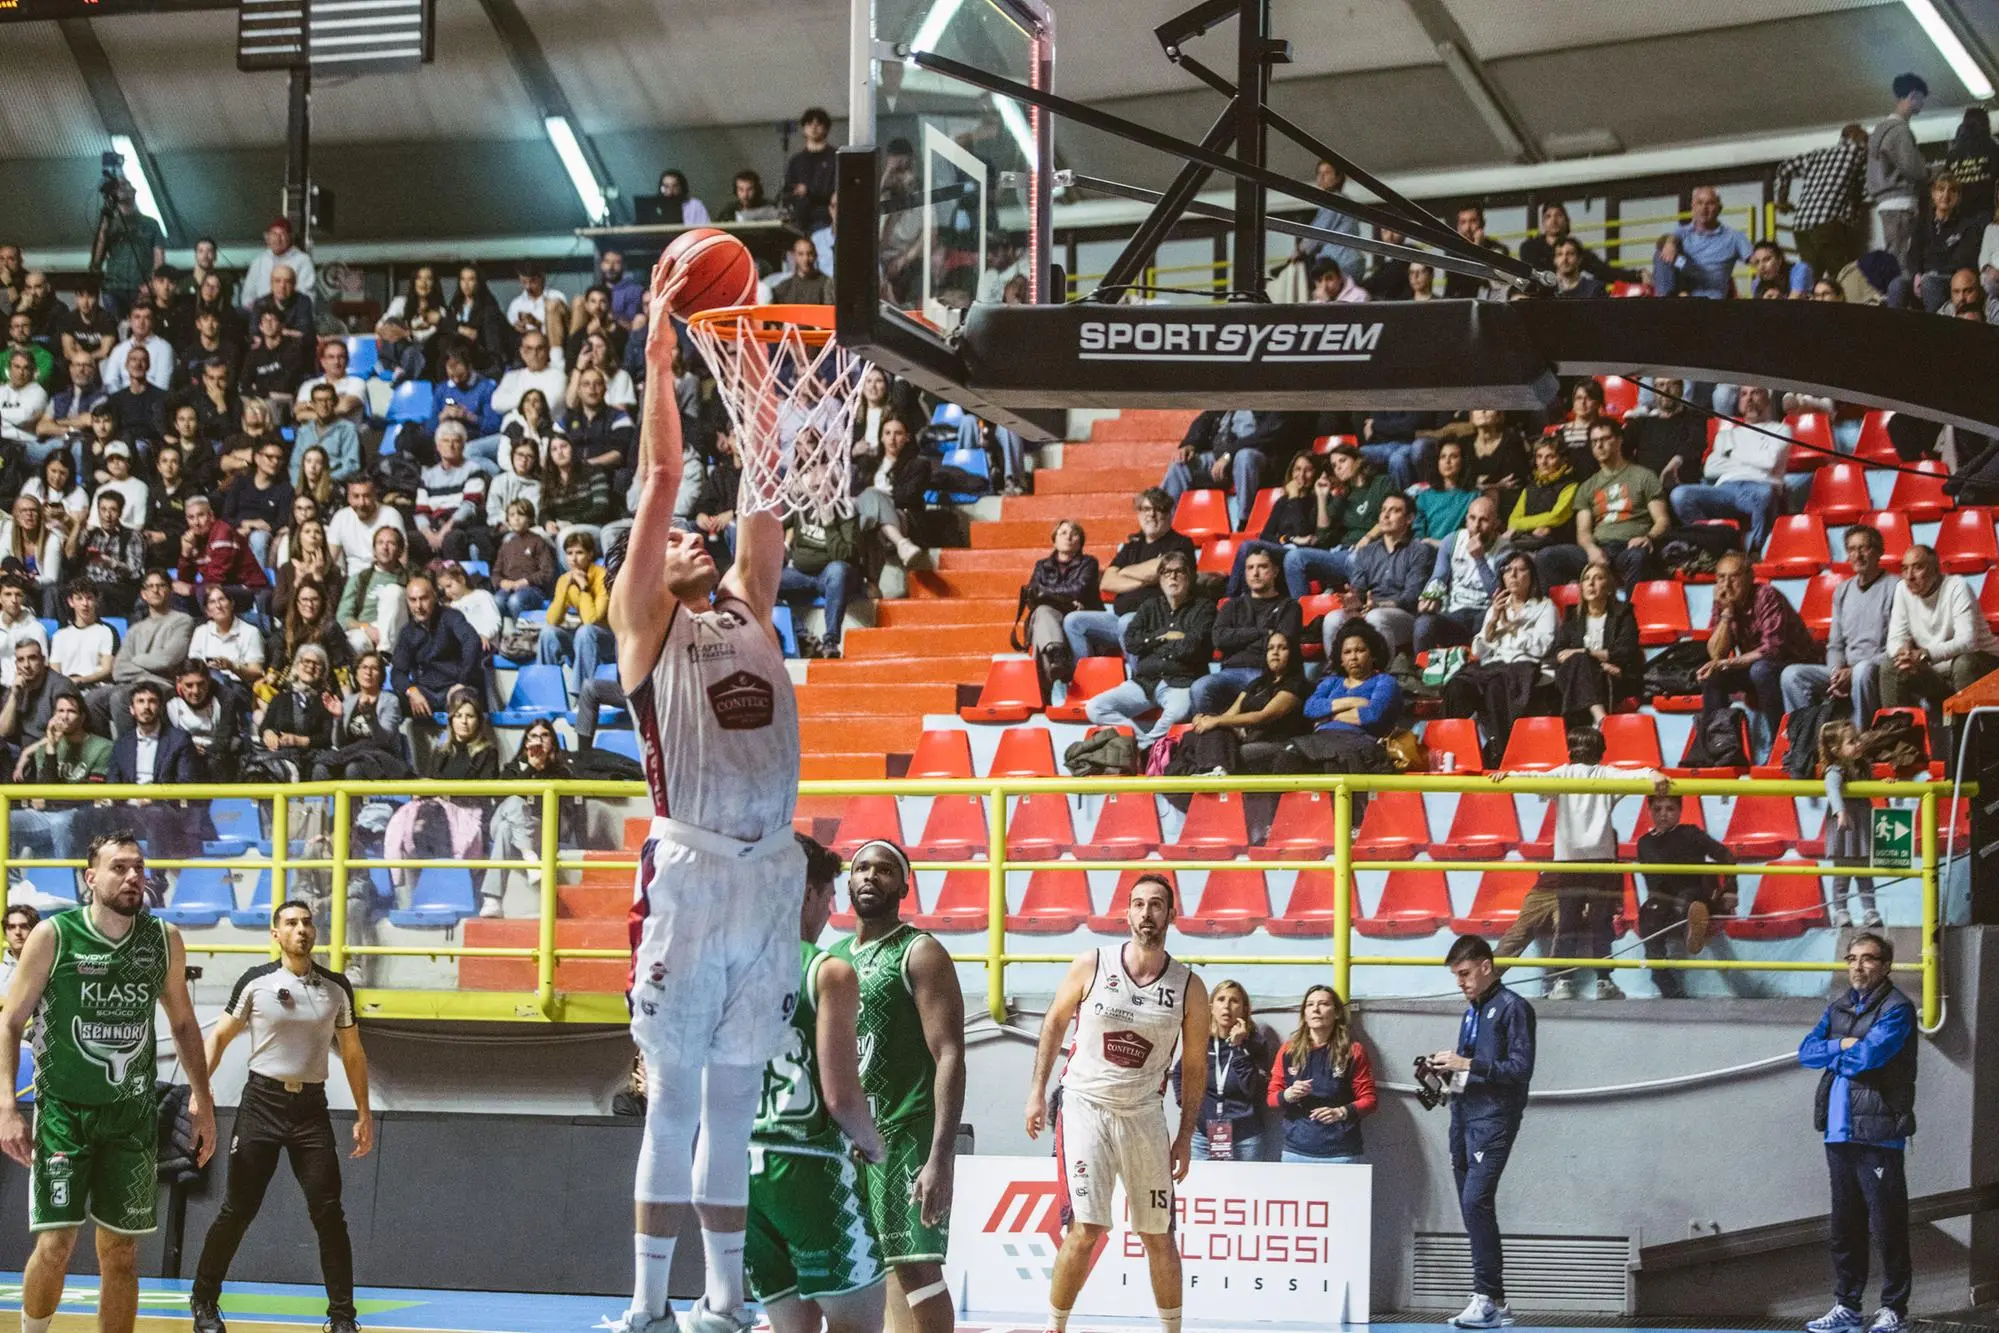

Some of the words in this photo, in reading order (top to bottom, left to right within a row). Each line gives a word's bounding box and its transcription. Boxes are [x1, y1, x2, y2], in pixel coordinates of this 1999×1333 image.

[1079, 321, 1384, 356] SPORTSYSTEM
[80, 981, 150, 1002] KLASS
[1157, 987, 1175, 1009] 15
[133, 1074, 147, 1096] 3
[51, 1180, 69, 1207] 3
[1150, 1189, 1167, 1209] 15
[1124, 1197, 1329, 1228] ASSIMO
[1123, 1231, 1329, 1263] BLDUSSI
[1122, 1272, 1329, 1292] IFISSI
